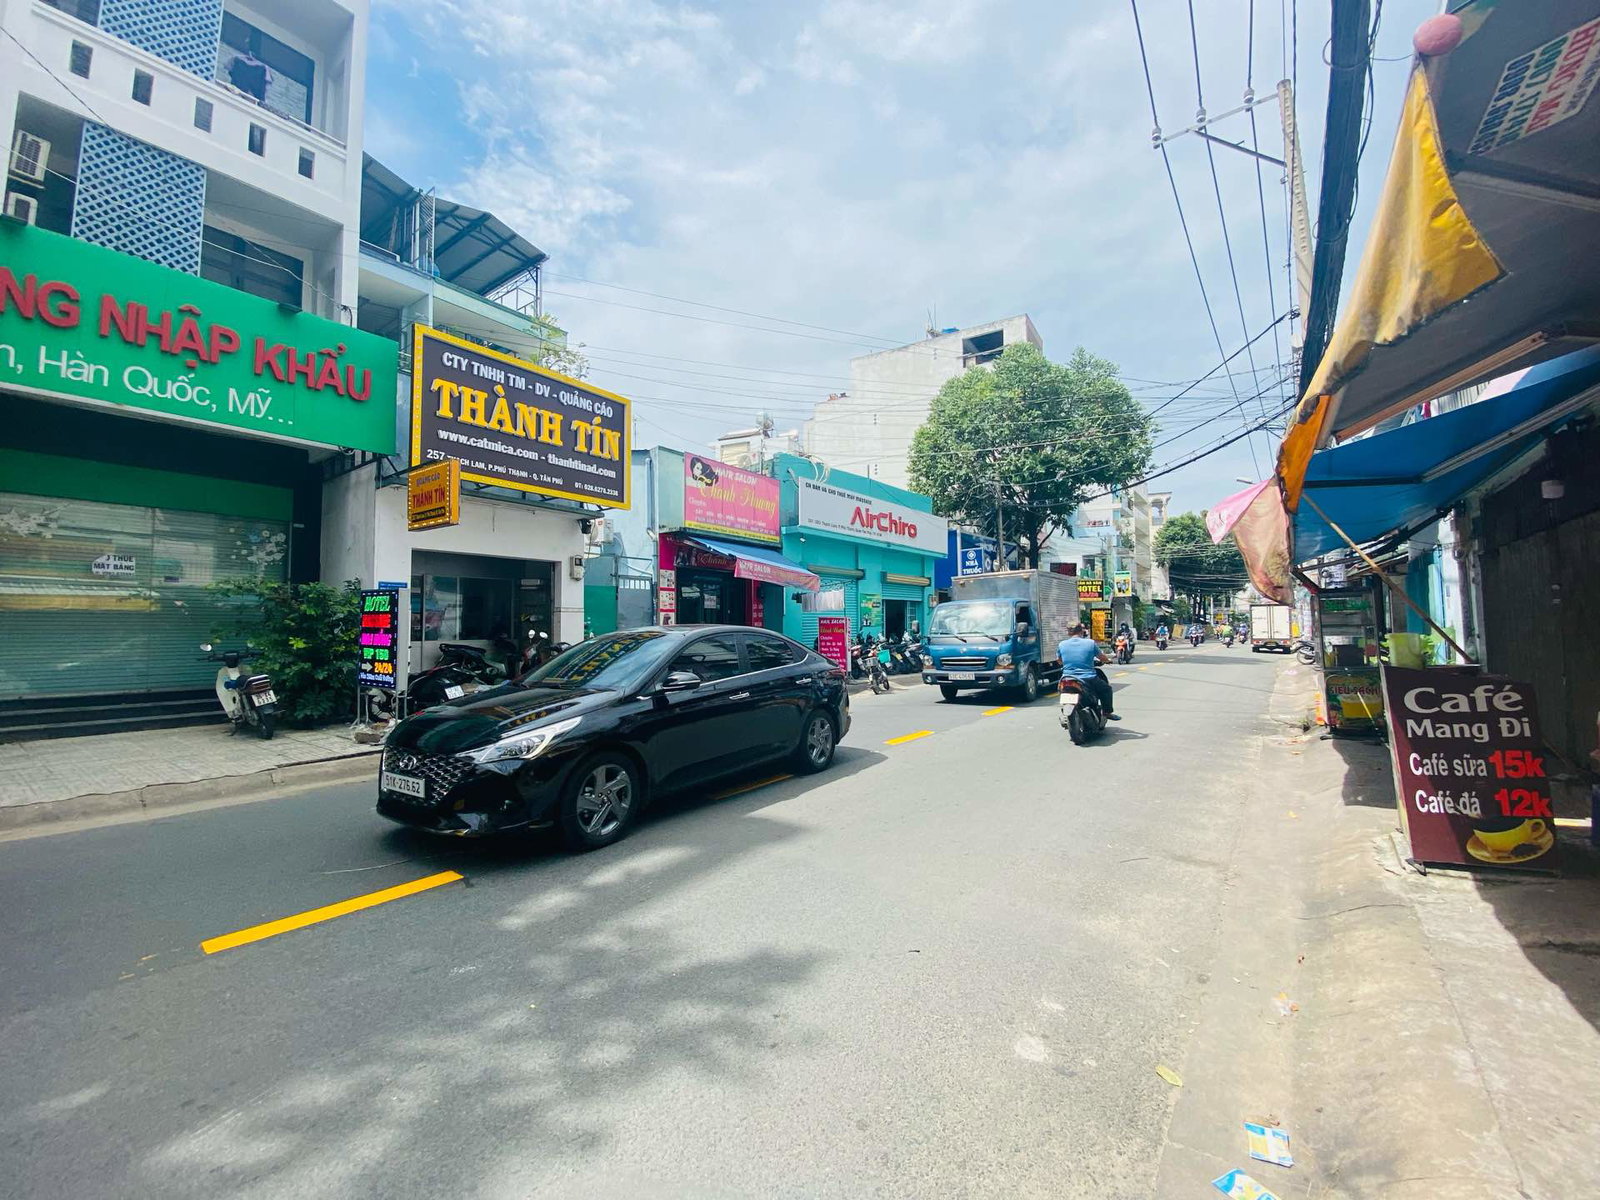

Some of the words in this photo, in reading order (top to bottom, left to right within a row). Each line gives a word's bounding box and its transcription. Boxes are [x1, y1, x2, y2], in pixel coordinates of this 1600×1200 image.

[99, 294, 241, 369] NHẬP
[254, 343, 372, 401] KHẨU
[38, 345, 109, 388] Hàn
[123, 366, 217, 413] Quốc,
[228, 387, 294, 426] Mỹ...
[442, 351, 469, 372] CTY
[471, 360, 505, 384] TNHH
[507, 373, 526, 390] TM
[535, 382, 550, 398] DV
[559, 390, 593, 413] QUẢNG
[593, 401, 613, 418] CÁO
[430, 378, 563, 446] THÀNH
[571, 416, 621, 461] TÍN
[426, 448, 445, 460] 257
[437, 429, 538, 460] www.catmica.com
[547, 453, 616, 478] thanhtinad.com
[413, 487, 433, 510] THÀNH
[435, 484, 445, 504] TÍN
[850, 506, 918, 539] AirChiro
[364, 595, 391, 612] HOTEL
[1403, 684, 1524, 714] Café
[1406, 719, 1490, 743] Mang
[1499, 717, 1532, 738] Đi
[1409, 752, 1449, 776] Café
[1454, 754, 1488, 777] sữa
[1489, 750, 1547, 779] 15k
[1415, 789, 1455, 814] Café
[1458, 791, 1482, 815] đá
[1494, 789, 1554, 817] 12k
